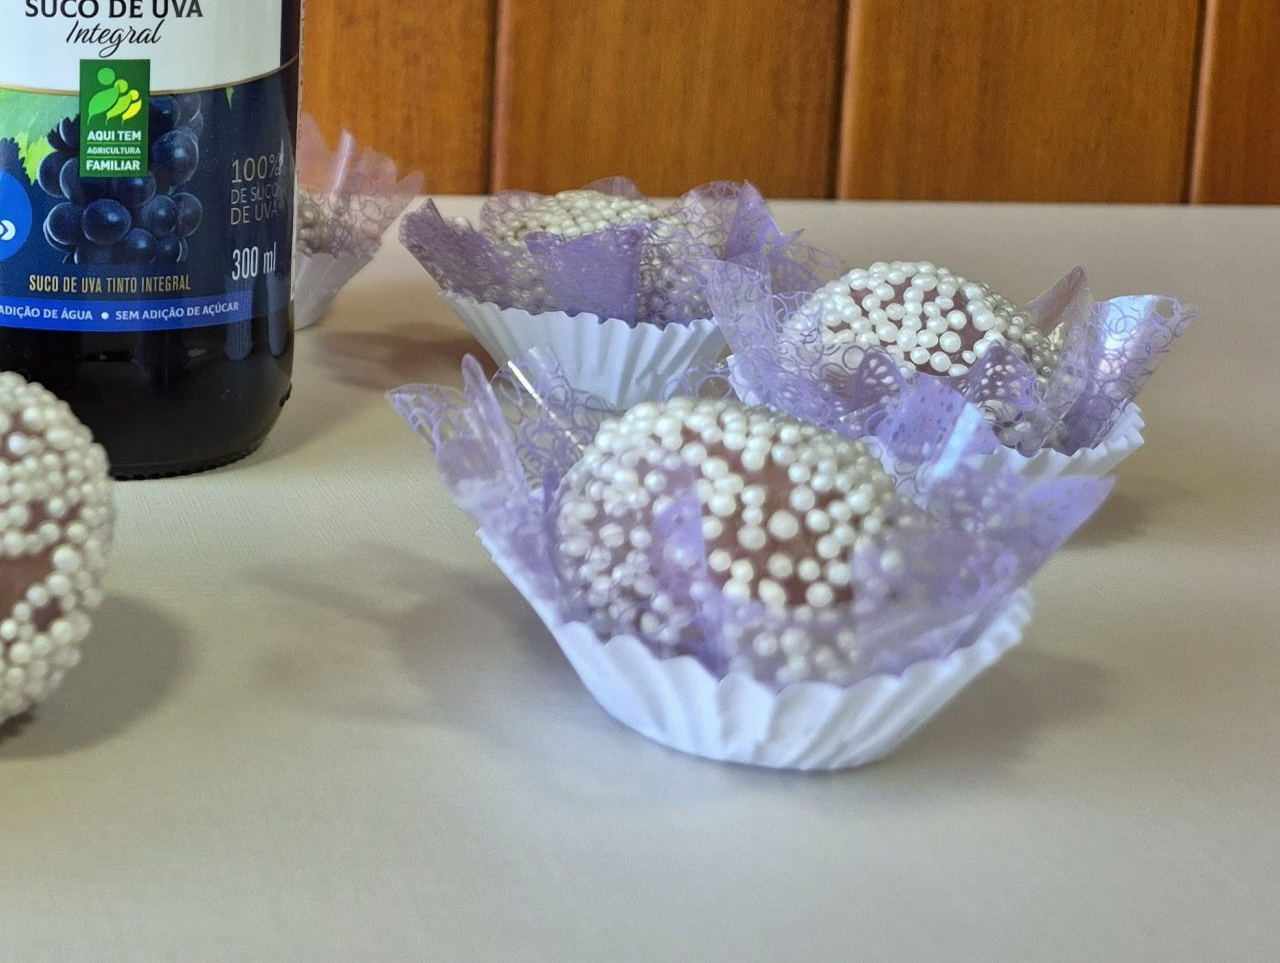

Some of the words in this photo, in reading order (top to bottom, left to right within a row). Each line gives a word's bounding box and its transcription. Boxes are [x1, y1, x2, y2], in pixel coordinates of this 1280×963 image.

[66, 19, 165, 59] Integral
[86, 130, 116, 141] AQUI
[117, 130, 142, 141] TEM
[86, 146, 141, 154] AGRICULTURA
[86, 160, 141, 171] FAMILIAR
[231, 153, 282, 183] 100%
[231, 188, 248, 204] DE
[250, 183, 280, 202] SUCO
[231, 205, 250, 225] DE
[255, 201, 279, 221] UVA
[231, 246, 259, 281] 300
[263, 241, 277, 274] ml
[29, 274, 59, 292] SUCO
[63, 276, 78, 292] DE
[81, 277, 103, 293] UVA
[106, 277, 137, 293] TINTO
[141, 274, 191, 293] INTEGRAL
[43, 309, 59, 319] DE
[61, 307, 94, 320] ÁGUA
[115, 310, 140, 320] SEM
[141, 306, 185, 322] ADIÇÃO
[186, 306, 201, 317] DE
[202, 301, 239, 316] AÇÚCAR
